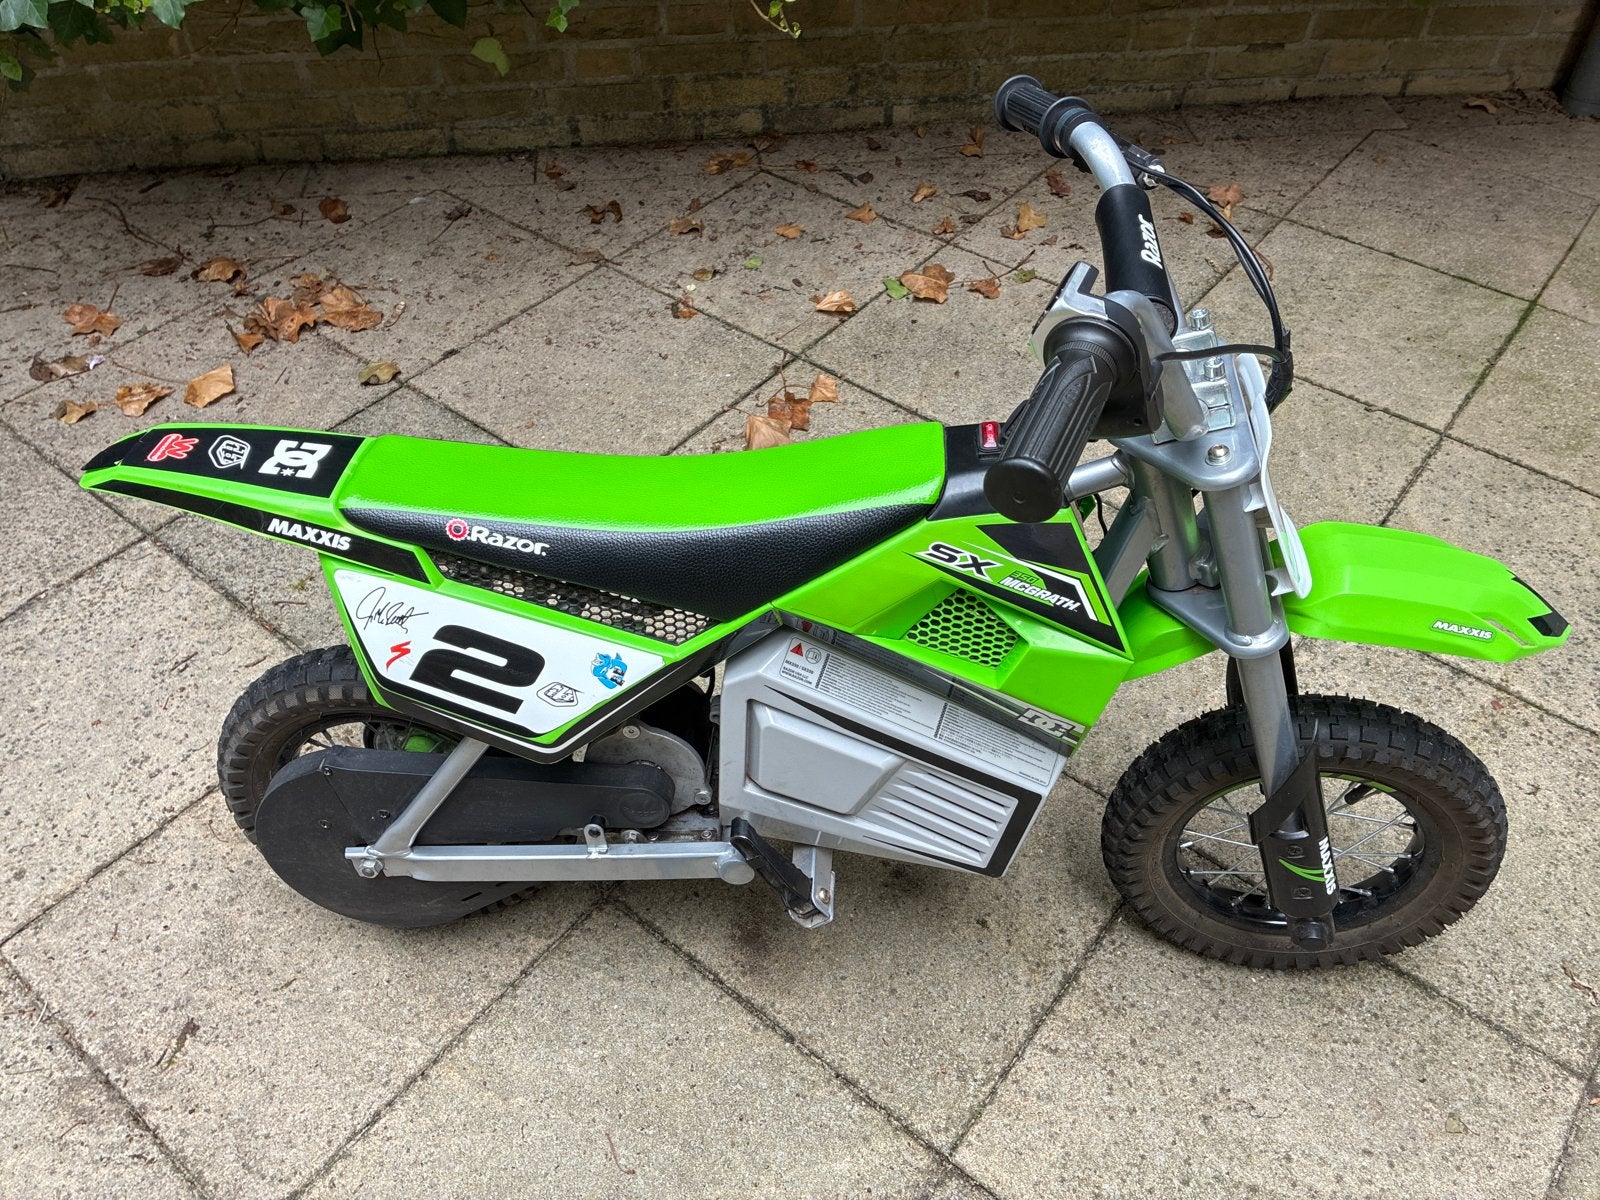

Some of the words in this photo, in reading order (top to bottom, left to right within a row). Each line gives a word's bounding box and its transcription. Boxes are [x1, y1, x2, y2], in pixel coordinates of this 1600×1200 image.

[1138, 213, 1163, 269] Razor
[267, 518, 351, 551] MAXXIS
[915, 541, 1003, 582] SX
[999, 577, 1082, 611] MCGRATH
[1432, 620, 1493, 640] MAXXIS
[409, 624, 546, 715] 2
[1318, 835, 1338, 896] MAXXIS
